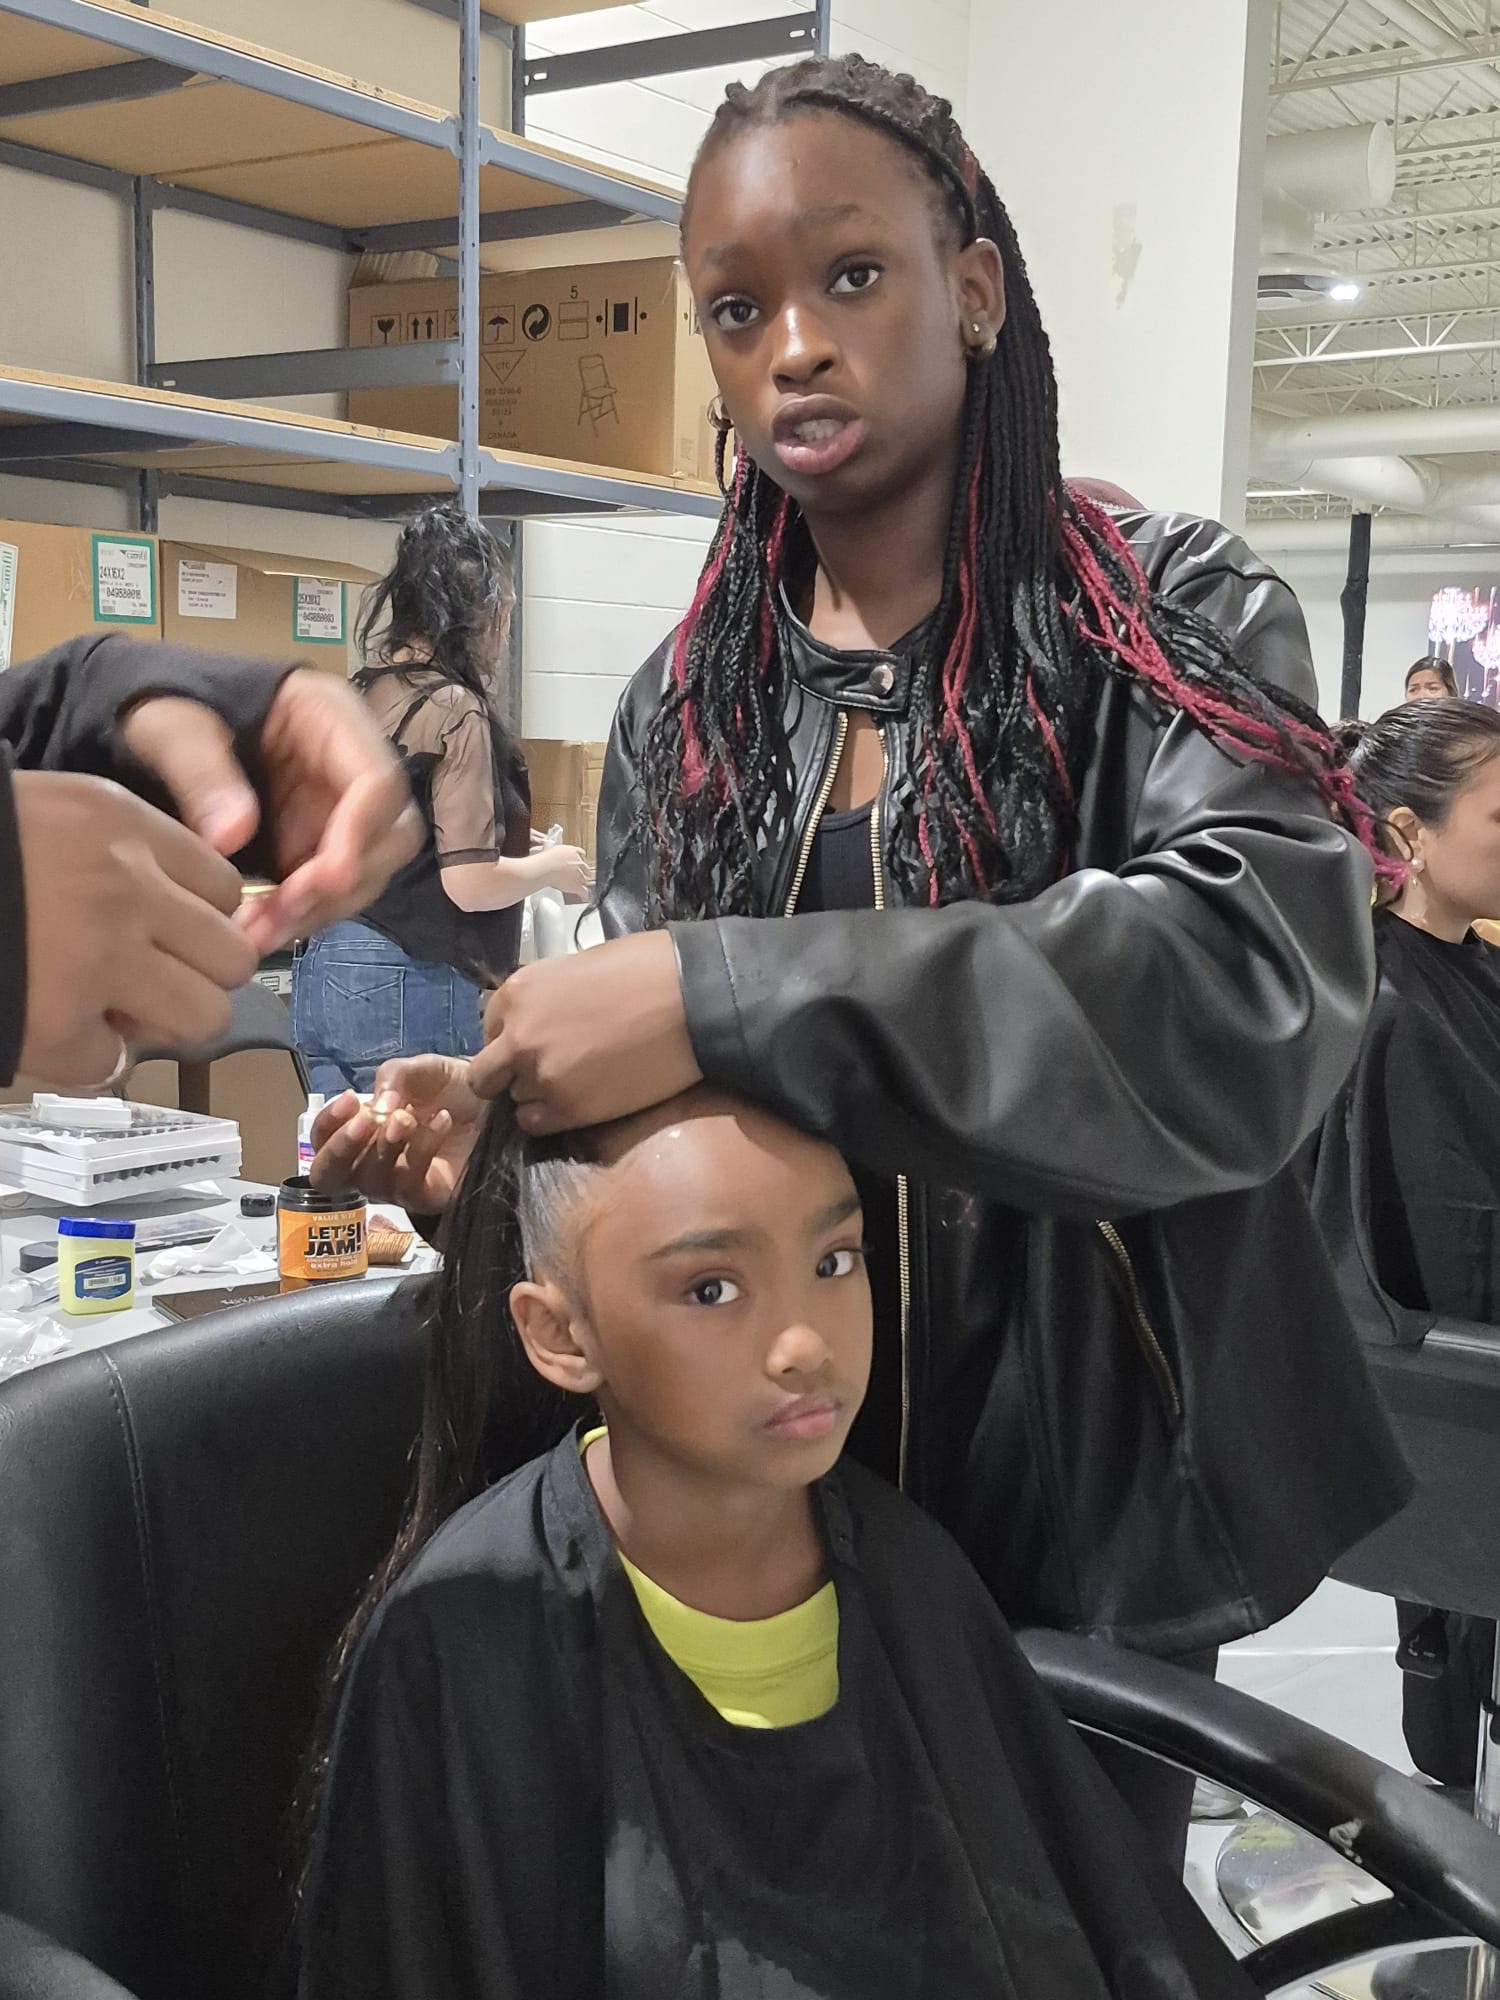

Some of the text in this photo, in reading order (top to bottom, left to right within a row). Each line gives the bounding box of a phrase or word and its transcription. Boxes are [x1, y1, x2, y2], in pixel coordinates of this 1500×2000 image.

[571, 286, 579, 299] 5
[312, 1214, 338, 1222] VALUE
[308, 1223, 356, 1240] LET'S
[310, 1262, 338, 1270] extra
